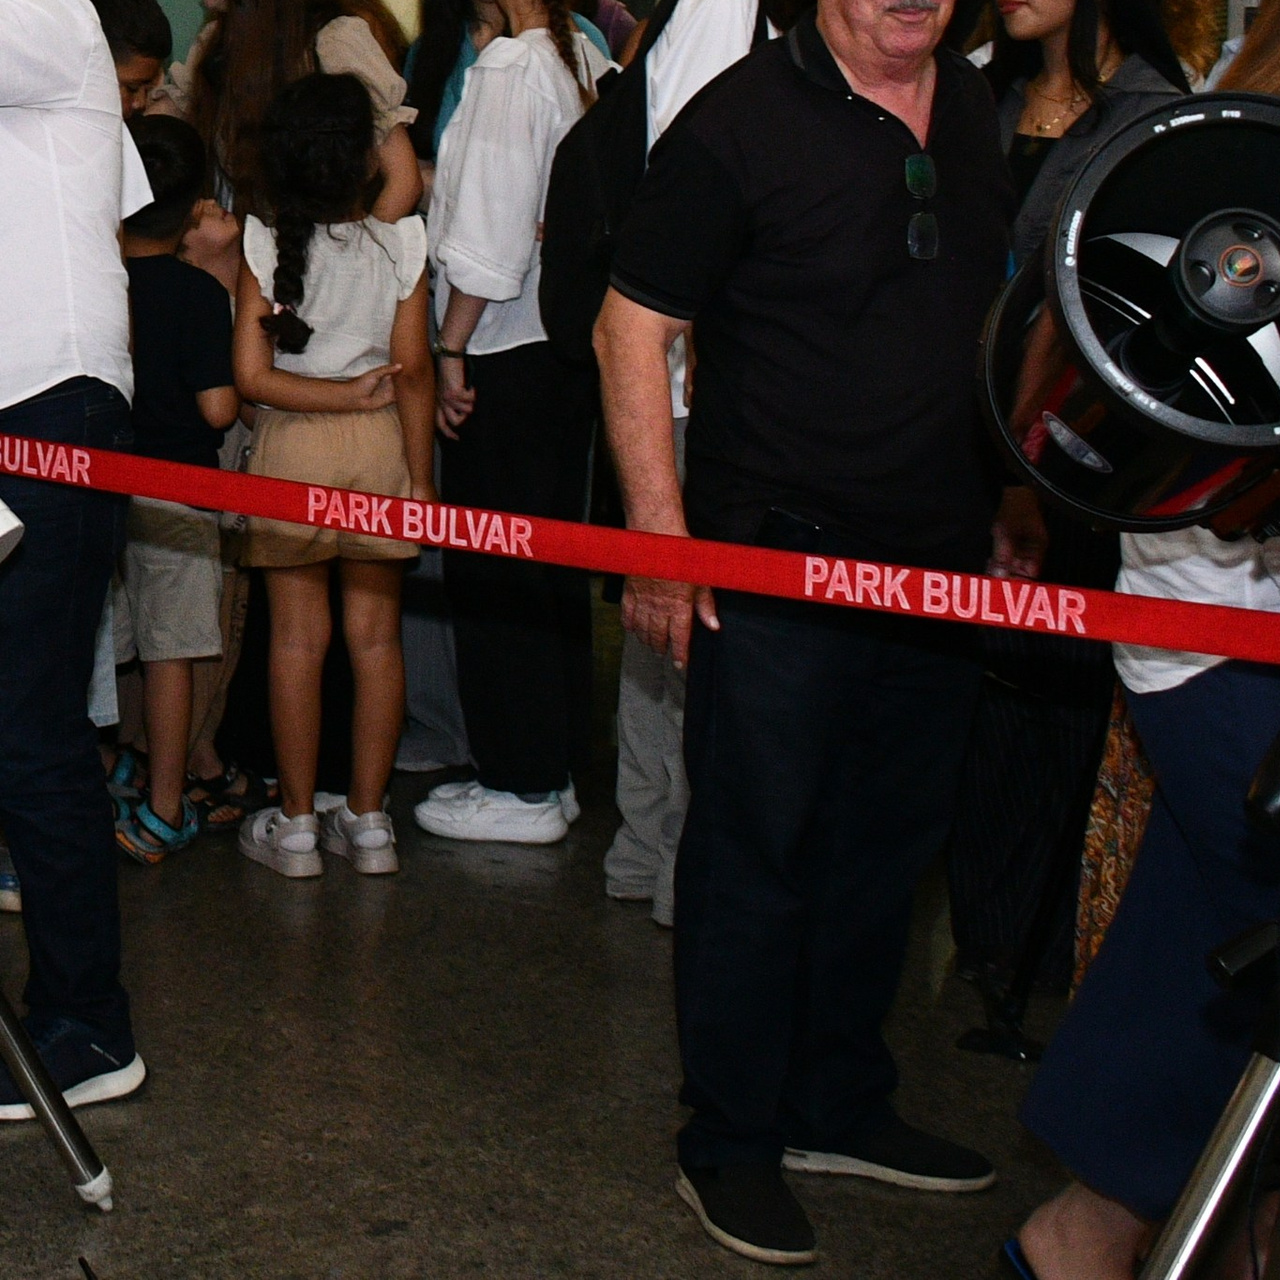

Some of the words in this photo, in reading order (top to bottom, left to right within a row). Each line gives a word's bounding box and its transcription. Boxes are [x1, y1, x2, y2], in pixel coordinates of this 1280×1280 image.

[1066, 210, 1082, 255] CELESTRON
[308, 486, 392, 536] PARK
[403, 501, 534, 558] BULVAR
[804, 556, 911, 610] PARK
[923, 572, 1087, 634] BULVAR
